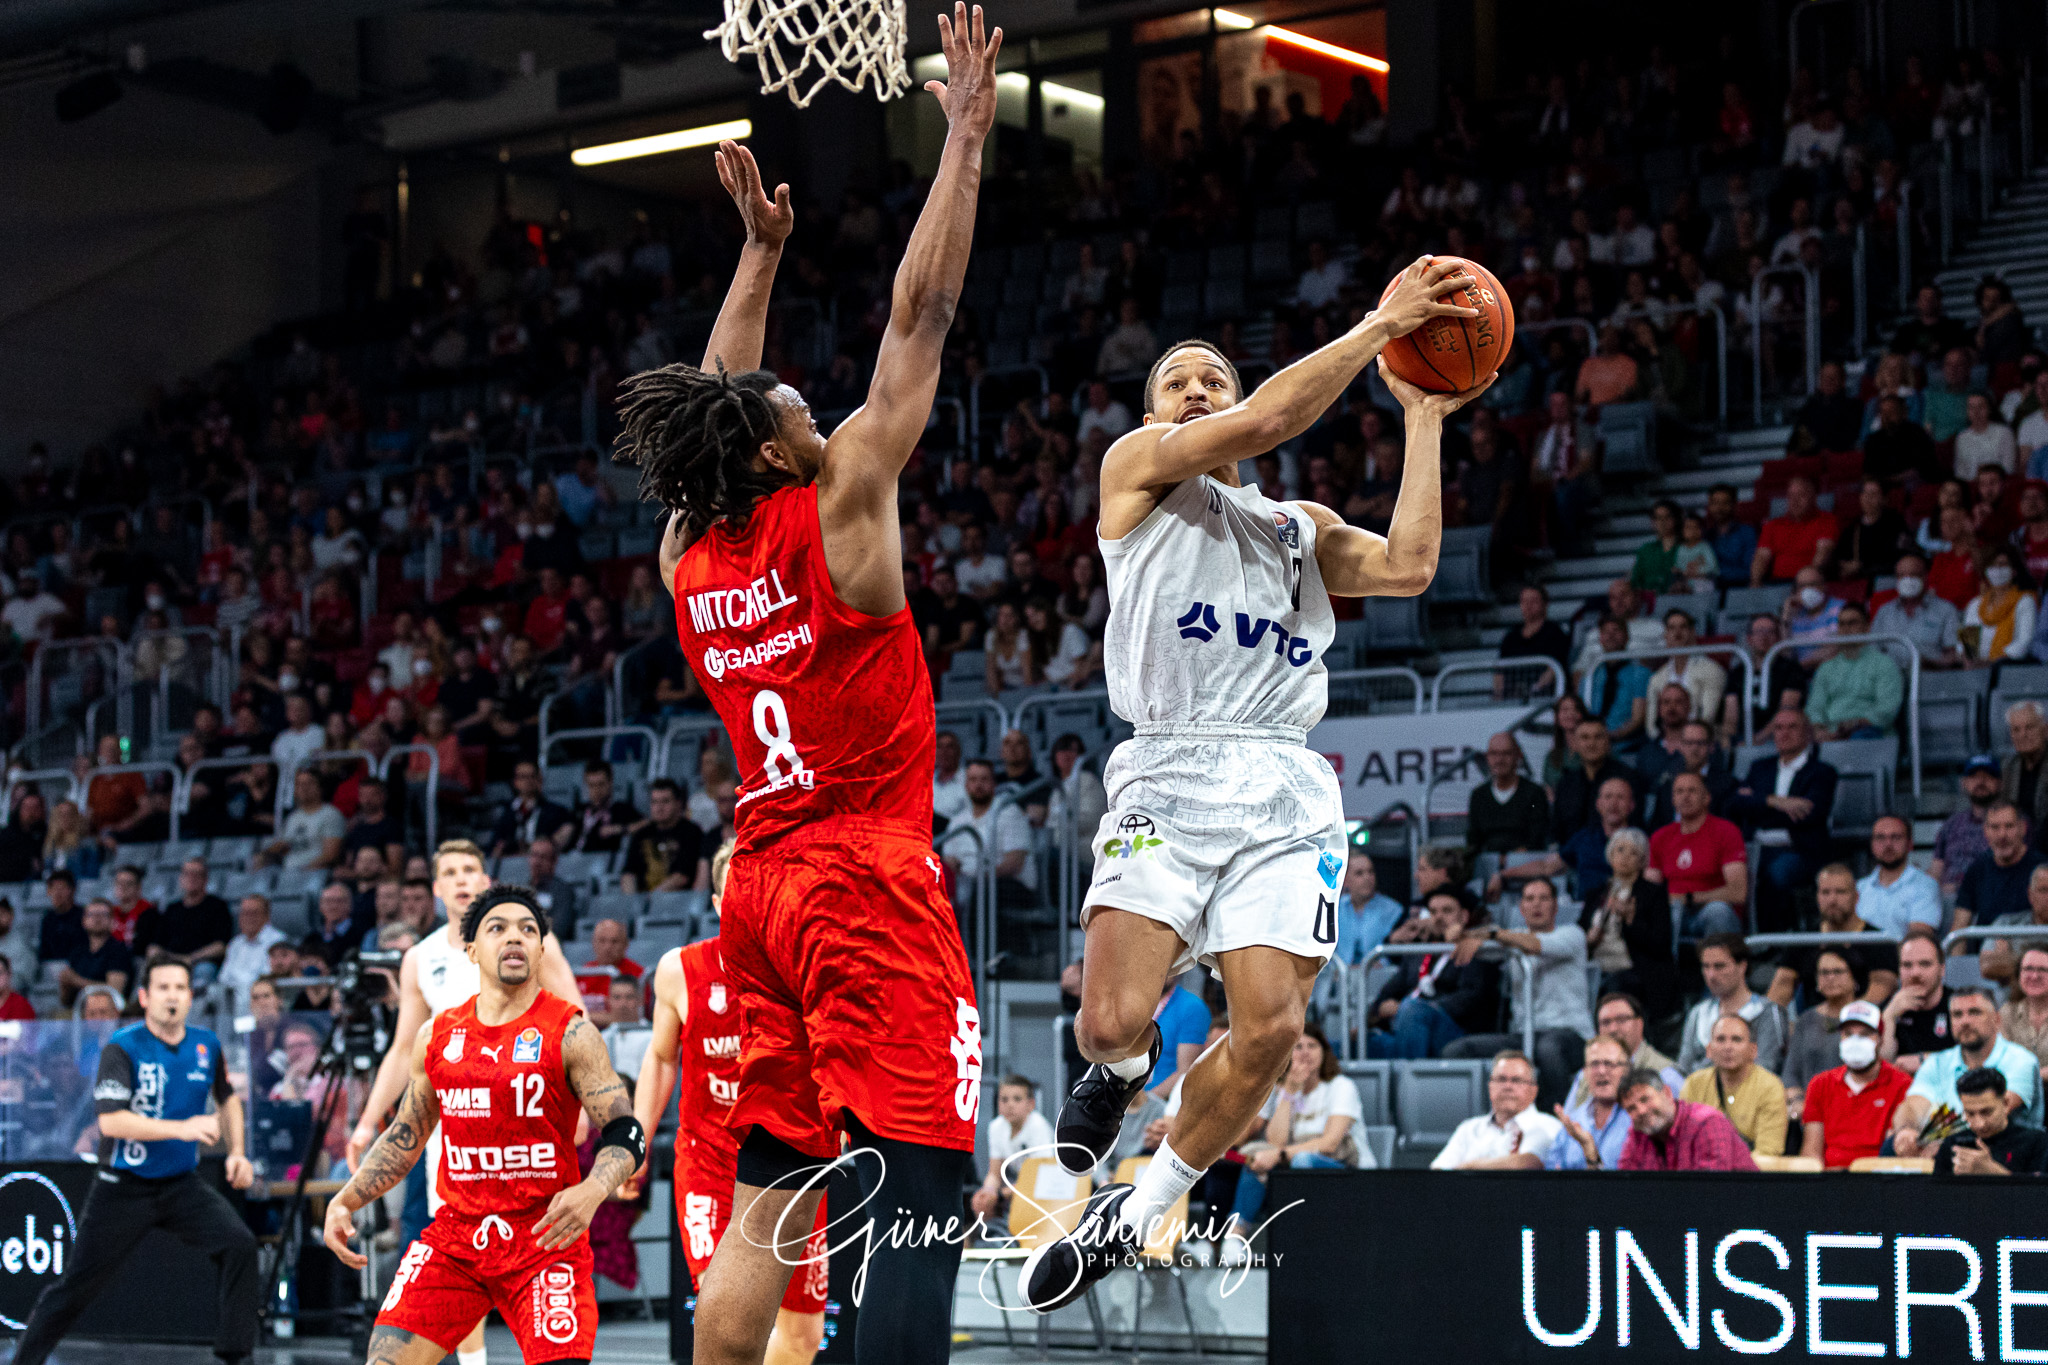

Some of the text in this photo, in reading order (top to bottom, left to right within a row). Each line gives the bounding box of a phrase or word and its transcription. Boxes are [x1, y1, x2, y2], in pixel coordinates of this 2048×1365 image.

[1235, 612, 1313, 668] VTG
[753, 689, 805, 785] 8
[510, 1072, 545, 1118] 12
[444, 1134, 557, 1171] brose
[1521, 1226, 2048, 1363] UNSERE
